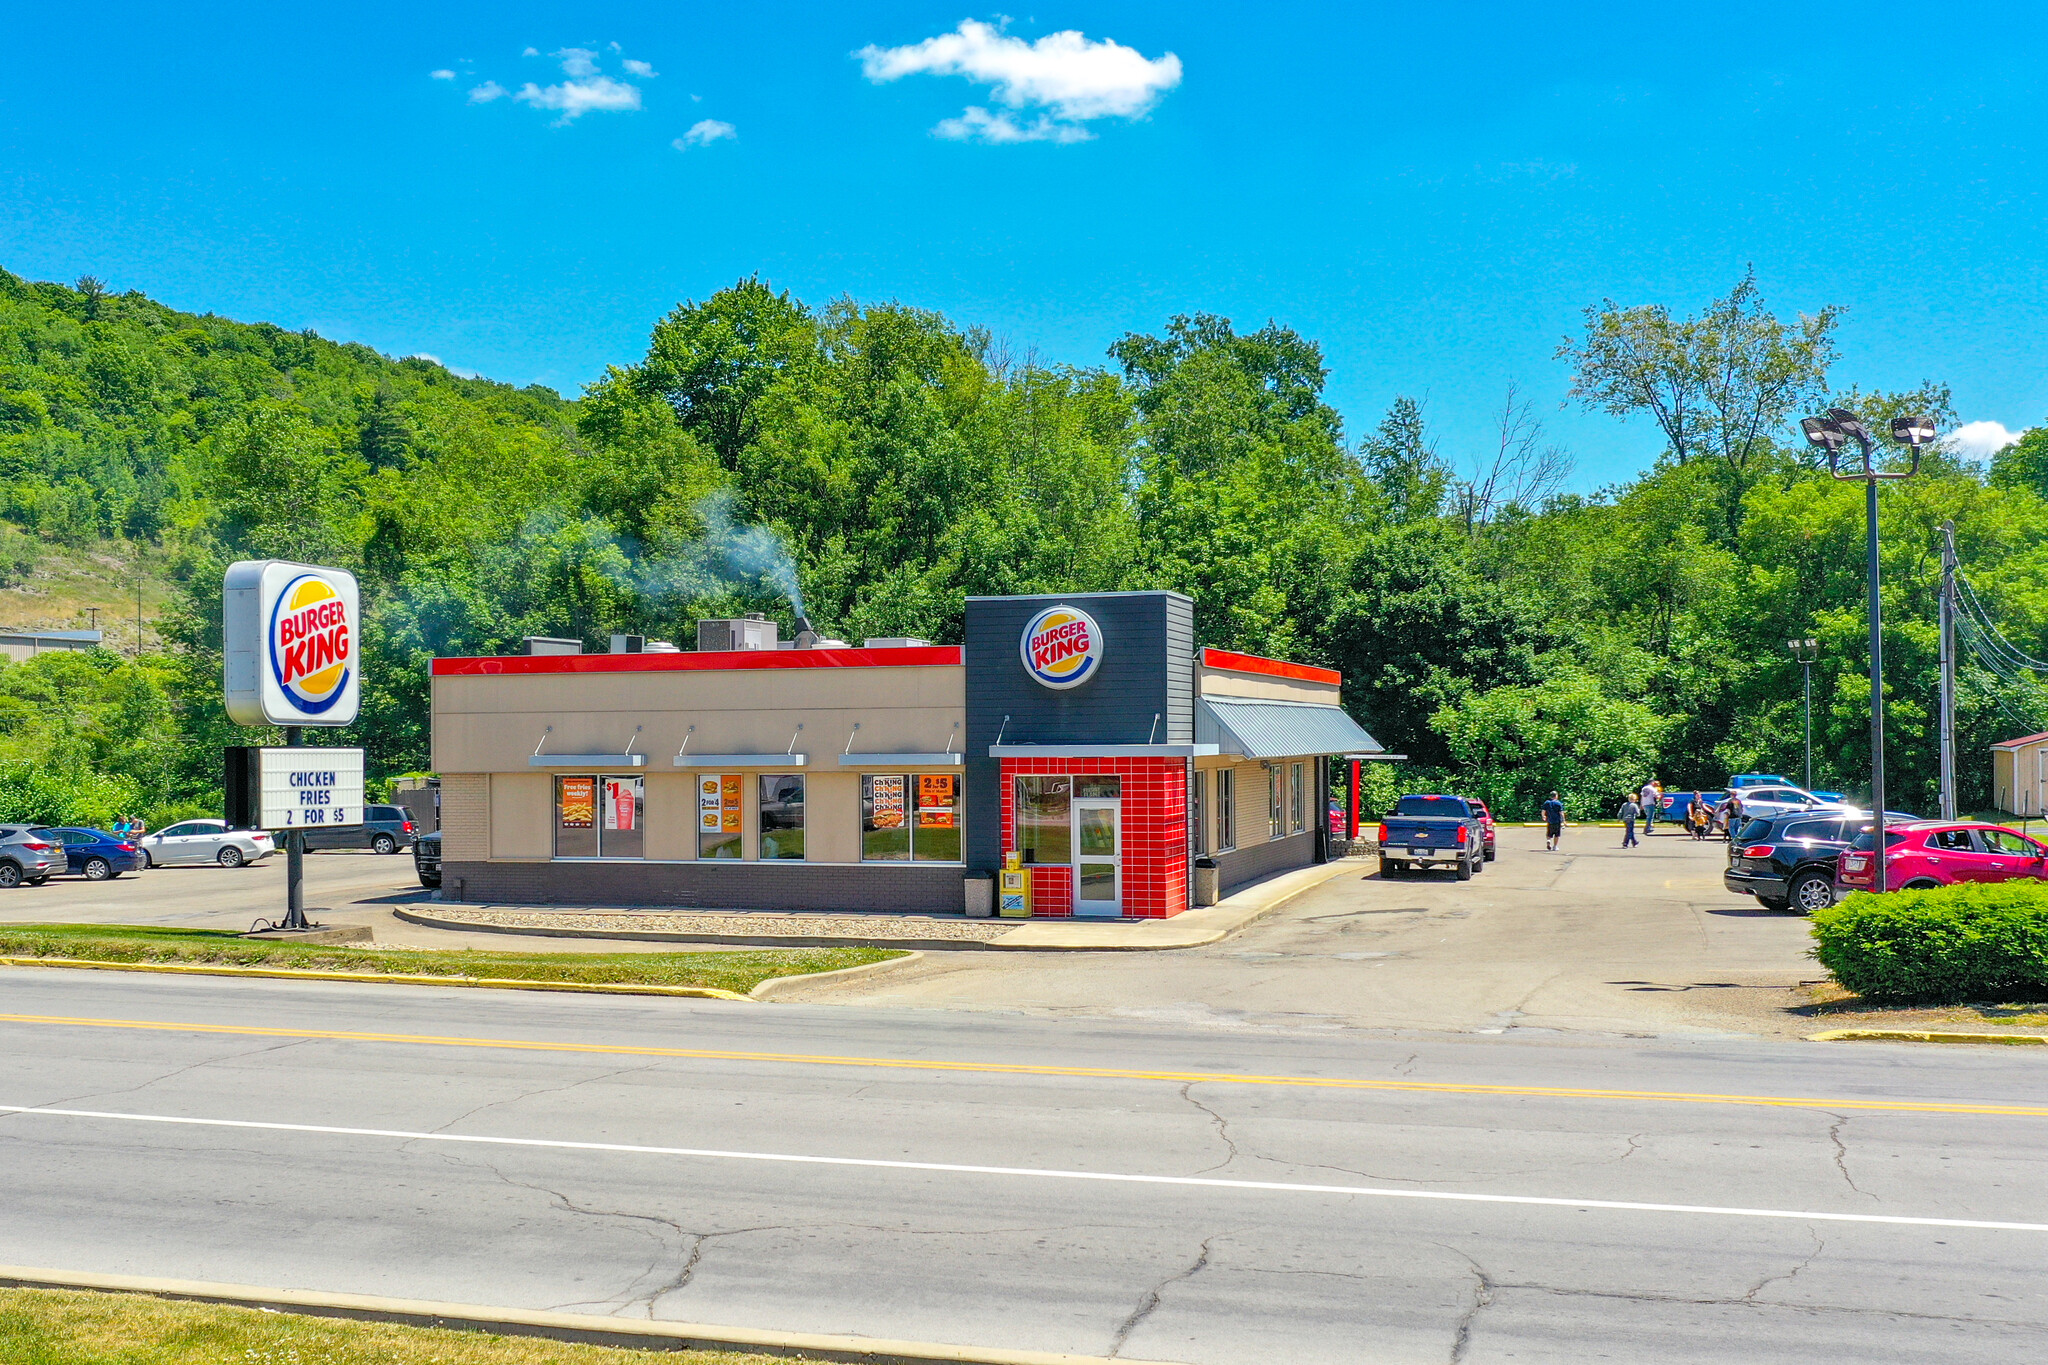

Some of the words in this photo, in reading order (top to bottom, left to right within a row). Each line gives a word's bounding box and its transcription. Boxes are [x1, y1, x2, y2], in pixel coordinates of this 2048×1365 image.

[280, 600, 346, 647] BURGER
[1032, 621, 1086, 652] BURGER
[282, 624, 349, 685] KING
[1034, 634, 1090, 670] KING
[289, 771, 336, 787] CHICKEN
[924, 778, 932, 788] 2
[300, 789, 331, 805] FRIES
[606, 782, 620, 799] $1
[286, 809, 293, 825] 2
[304, 808, 325, 824] FOR
[333, 807, 345, 822] $5
